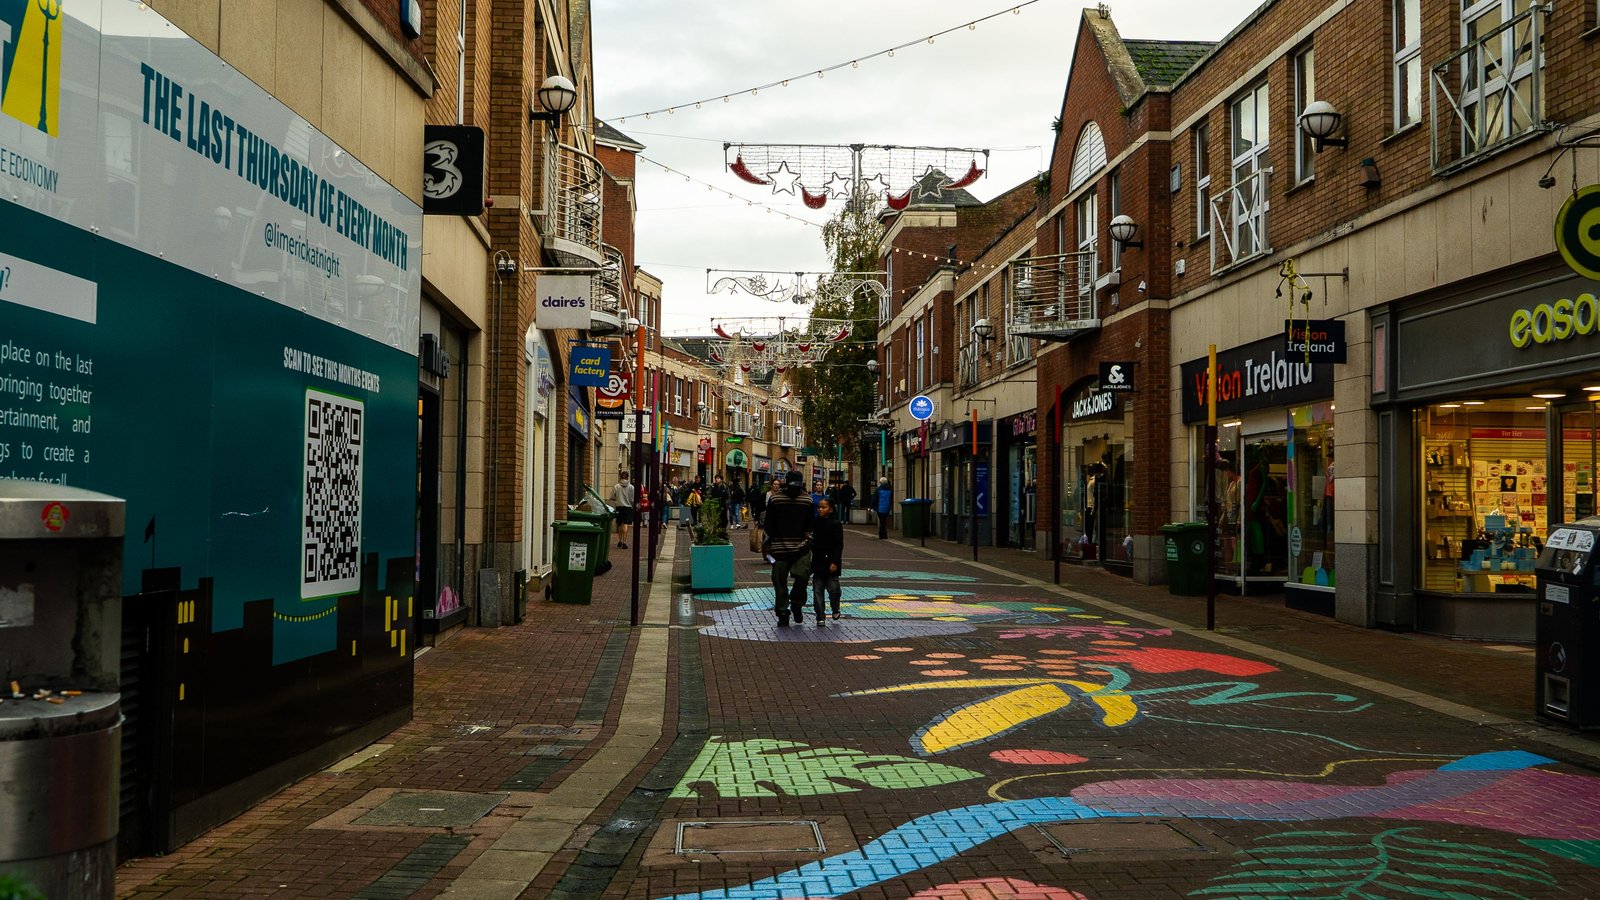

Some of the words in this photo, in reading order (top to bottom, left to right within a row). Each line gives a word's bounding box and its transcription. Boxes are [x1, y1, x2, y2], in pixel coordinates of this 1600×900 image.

[10, 153, 59, 193] ECONOMY
[140, 61, 183, 142] THE
[187, 93, 233, 170] LAST
[236, 124, 318, 217] THURSDAY
[318, 179, 334, 227] OF
[337, 190, 371, 250] EVERY
[373, 214, 407, 271] MONTH
[264, 222, 340, 278] @limerickatnight
[542, 296, 585, 307] claire's
[1509, 292, 1600, 348] easo
[1, 340, 30, 364] place
[36, 351, 49, 367] on
[55, 350, 71, 371] the
[76, 354, 92, 375] last
[284, 346, 302, 371] SCAN
[303, 352, 312, 373] TO
[312, 355, 323, 378] SEE
[324, 358, 338, 381] THIS
[338, 363, 361, 387] MONTHS
[361, 370, 379, 393] EVENTS
[580, 357, 601, 366] card
[574, 365, 605, 378] factory
[49, 382, 92, 405] together
[1072, 392, 1112, 418] JACK&JONES
[72, 416, 91, 434] and
[21, 441, 33, 460] to
[43, 445, 75, 463] create
[84, 449, 90, 463] a
